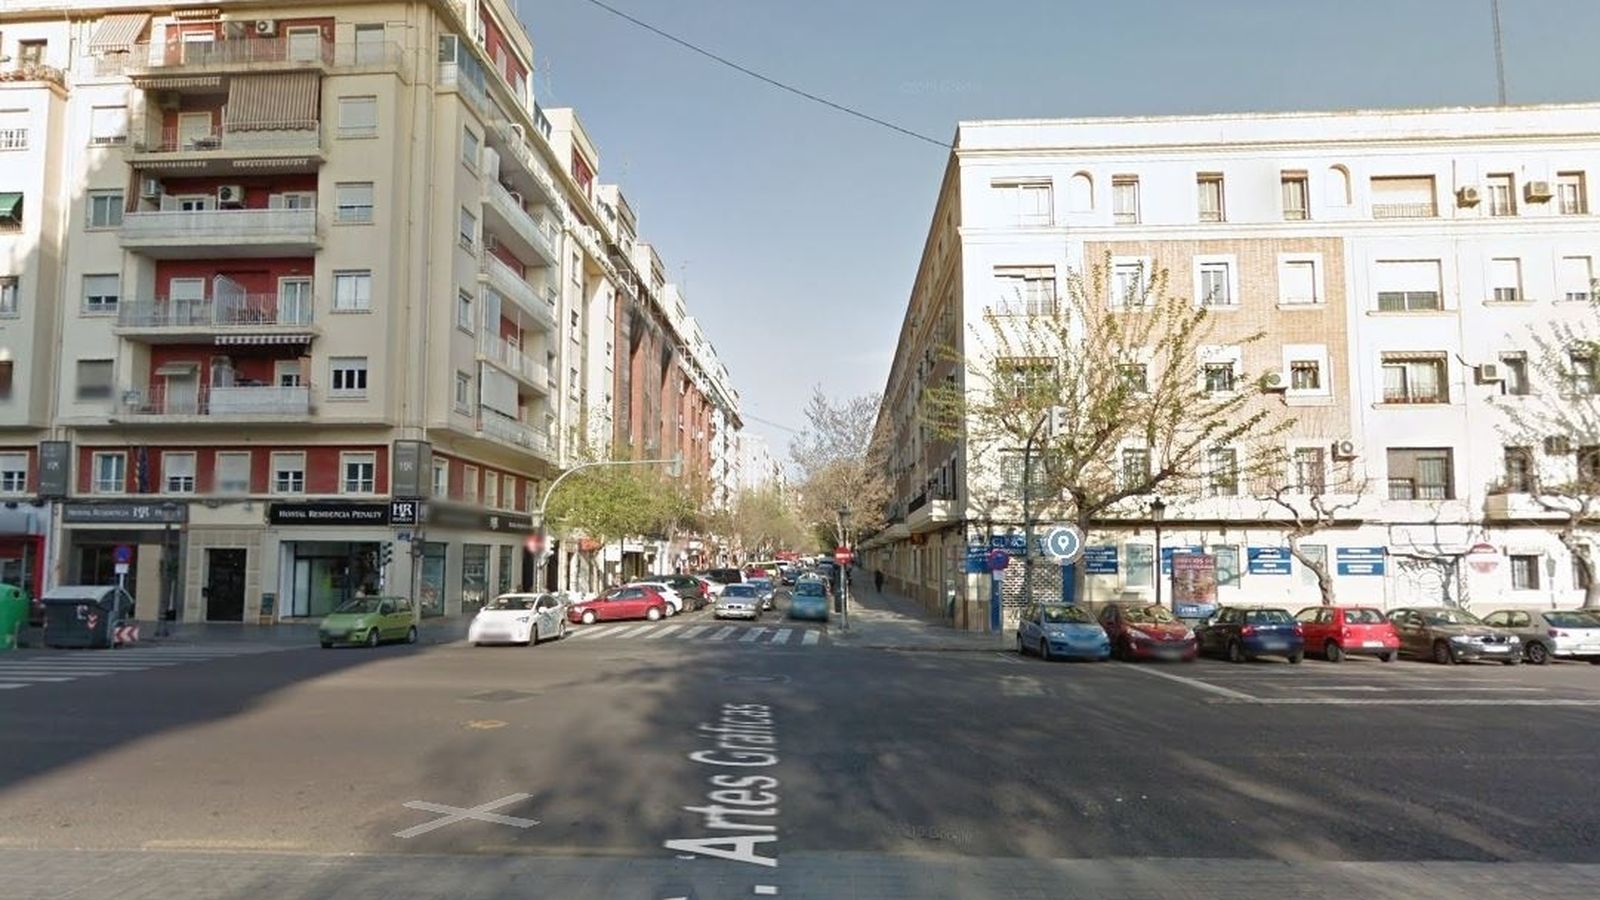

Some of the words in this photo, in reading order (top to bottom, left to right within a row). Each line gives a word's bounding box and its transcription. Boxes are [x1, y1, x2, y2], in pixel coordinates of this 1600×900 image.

[279, 510, 306, 518] HOSTAL
[308, 510, 350, 518] RESIDENCIA
[352, 510, 382, 518] PENALTY
[392, 503, 413, 517] HR
